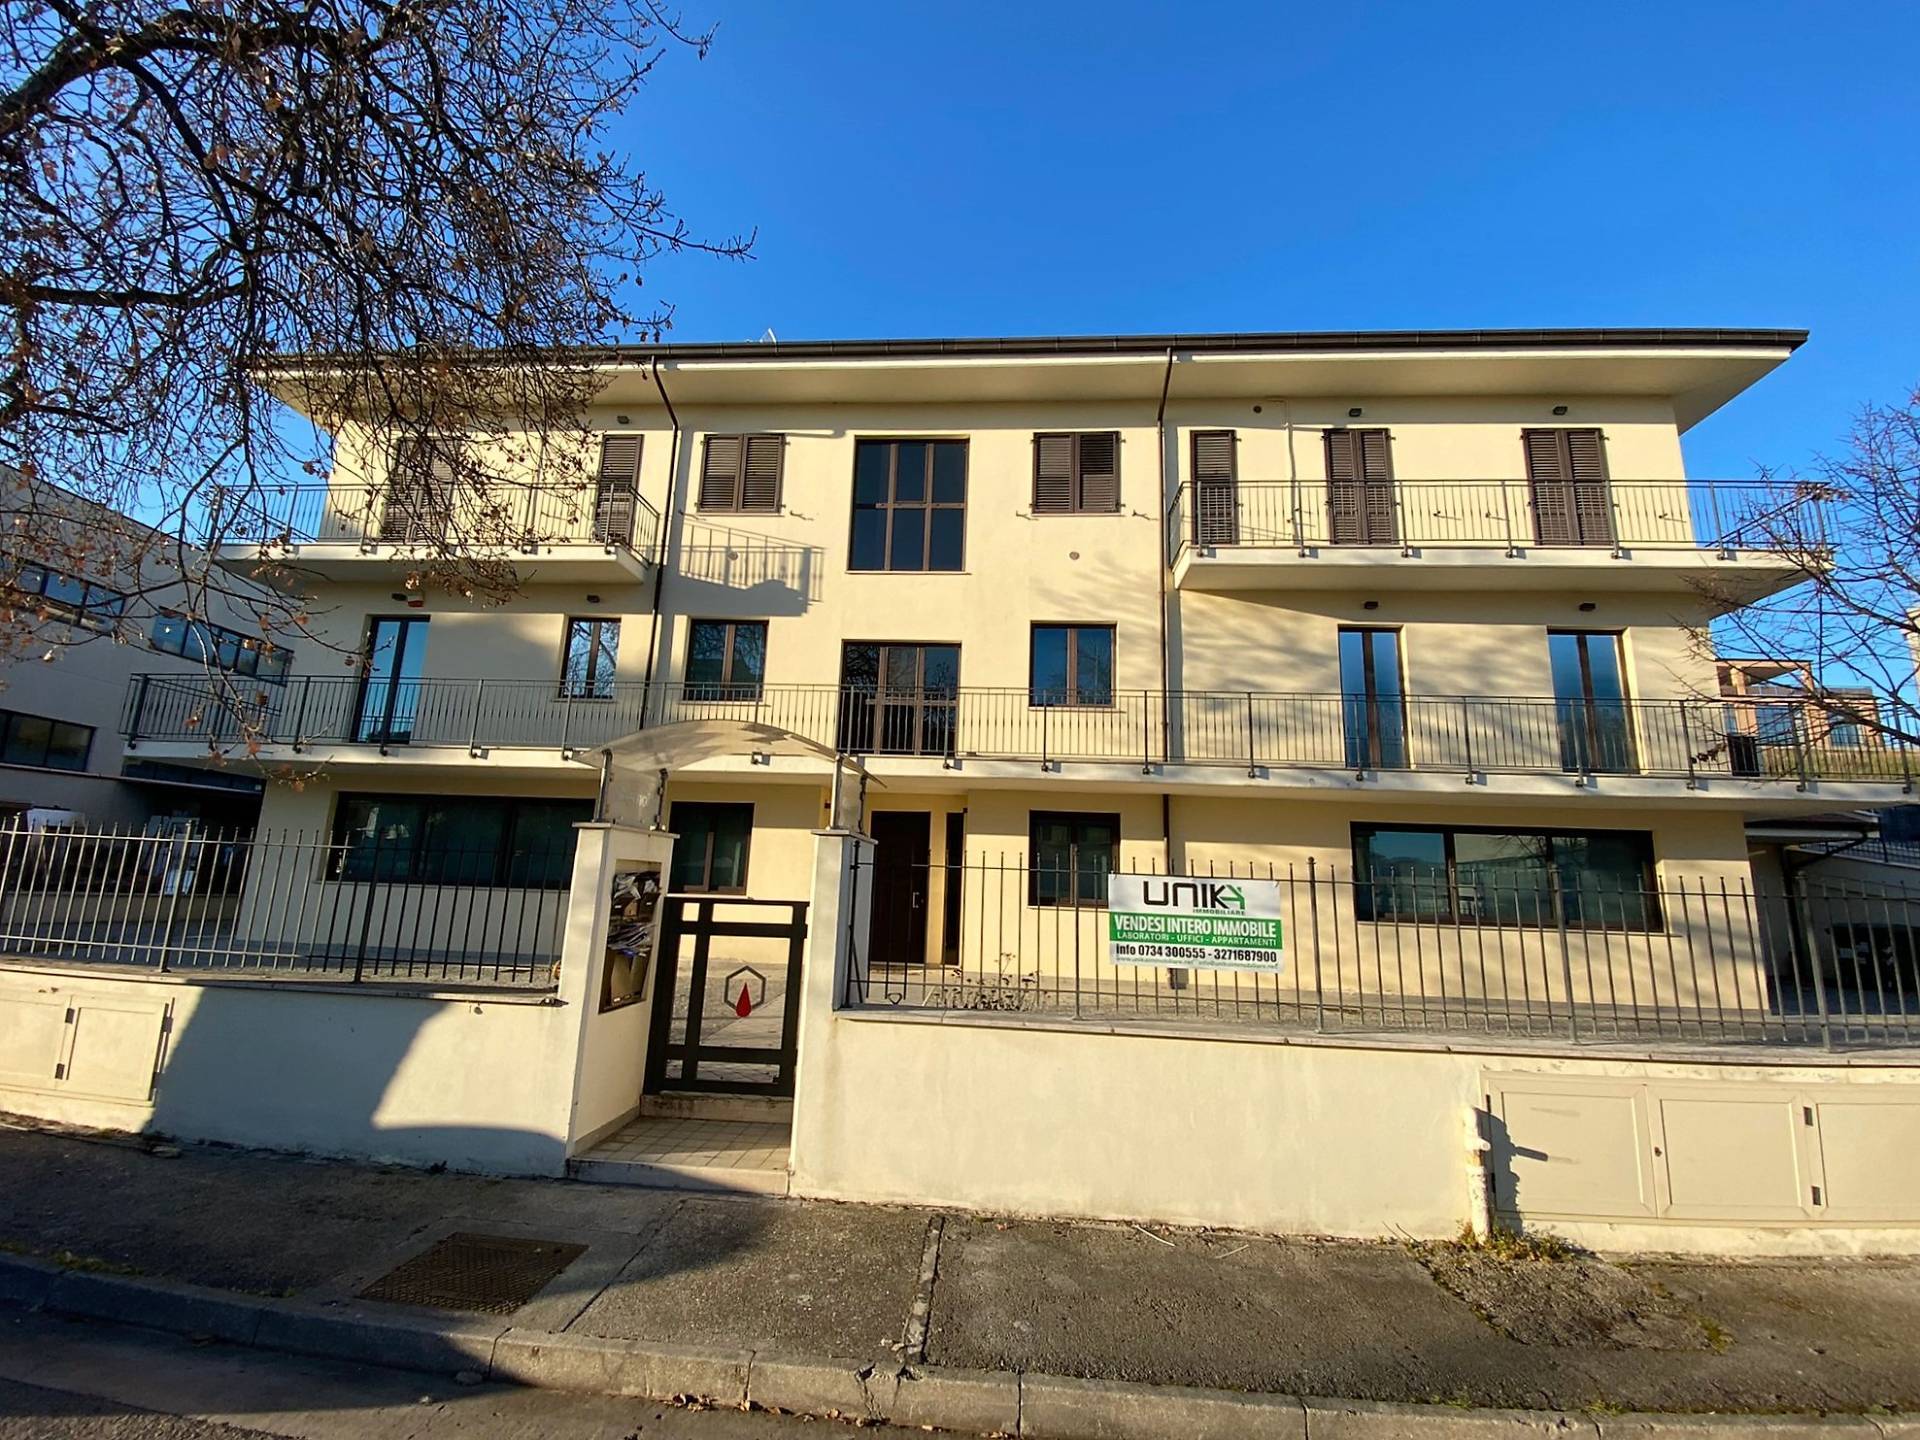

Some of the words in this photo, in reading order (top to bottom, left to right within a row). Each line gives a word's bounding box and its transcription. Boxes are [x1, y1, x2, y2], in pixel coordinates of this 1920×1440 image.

[1193, 908, 1245, 916] IMMOBILIARE
[1115, 915, 1164, 933] VENDESI
[1167, 918, 1211, 935] INTERO
[1213, 920, 1276, 938] IMMOBILE
[1117, 932, 1169, 941] LABORATORI
[1177, 934, 1204, 944] UFFICI
[1211, 936, 1277, 946] APPARTAMENTI
[1138, 945, 1162, 956] 0734
[1165, 946, 1206, 959] 300555
[1214, 948, 1277, 962] 3271687900
